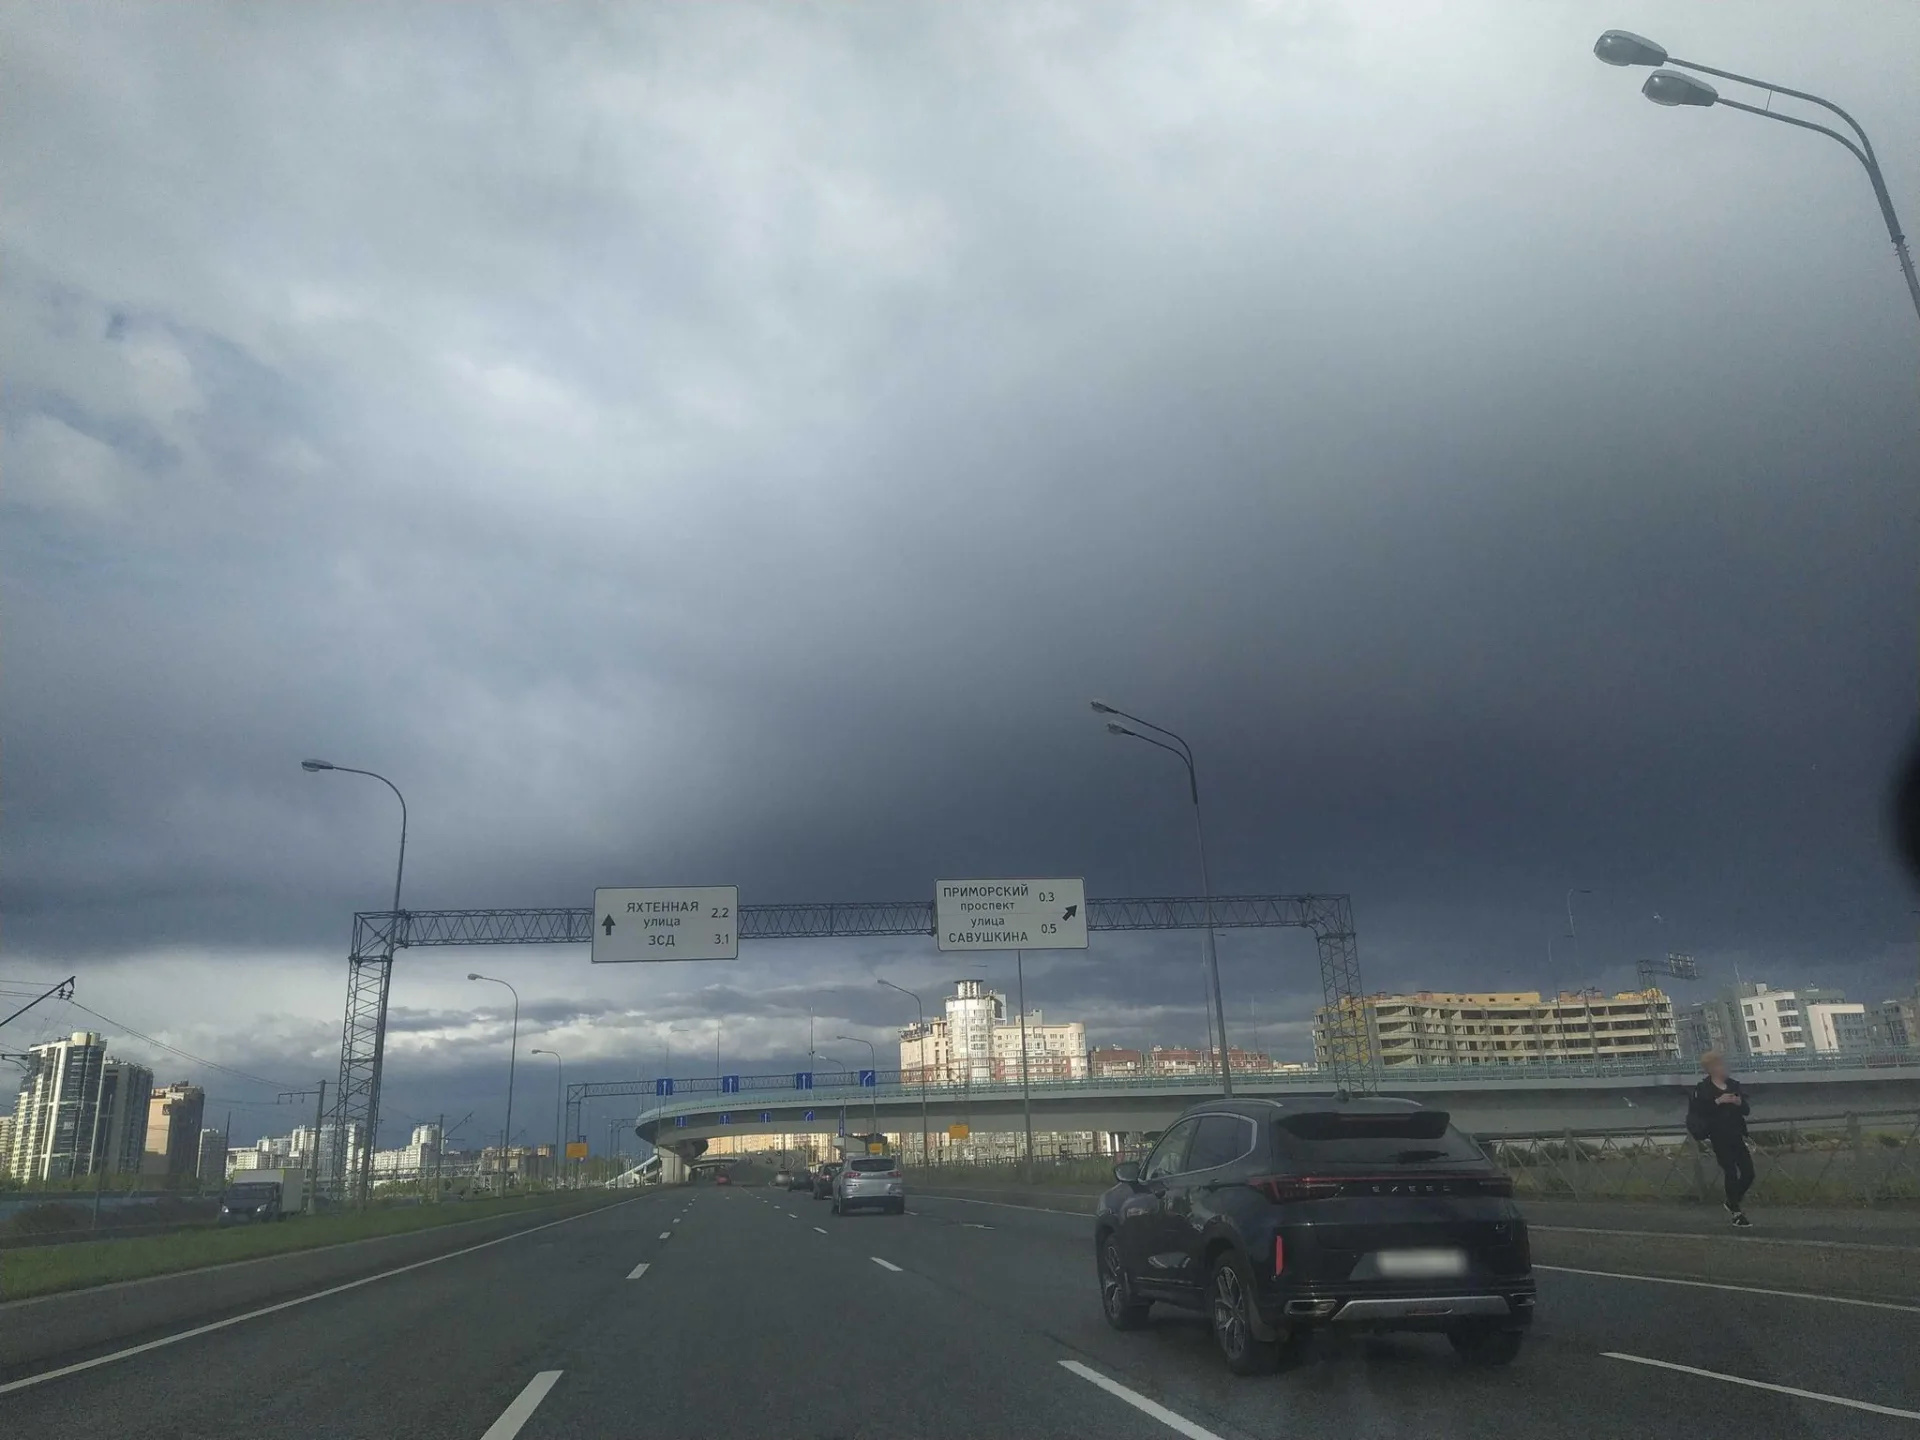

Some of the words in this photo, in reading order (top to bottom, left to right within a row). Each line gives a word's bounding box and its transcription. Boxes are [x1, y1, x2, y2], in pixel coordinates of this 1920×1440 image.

[944, 884, 1029, 897] ПРИМОРСКИЙ
[626, 901, 699, 913] ЯХТЕННАЯ
[961, 902, 1015, 912] проспект
[643, 918, 680, 929] улица
[971, 918, 1005, 928] улица
[648, 935, 675, 946] ЗСД
[949, 931, 1028, 943] САВУШКИНА
